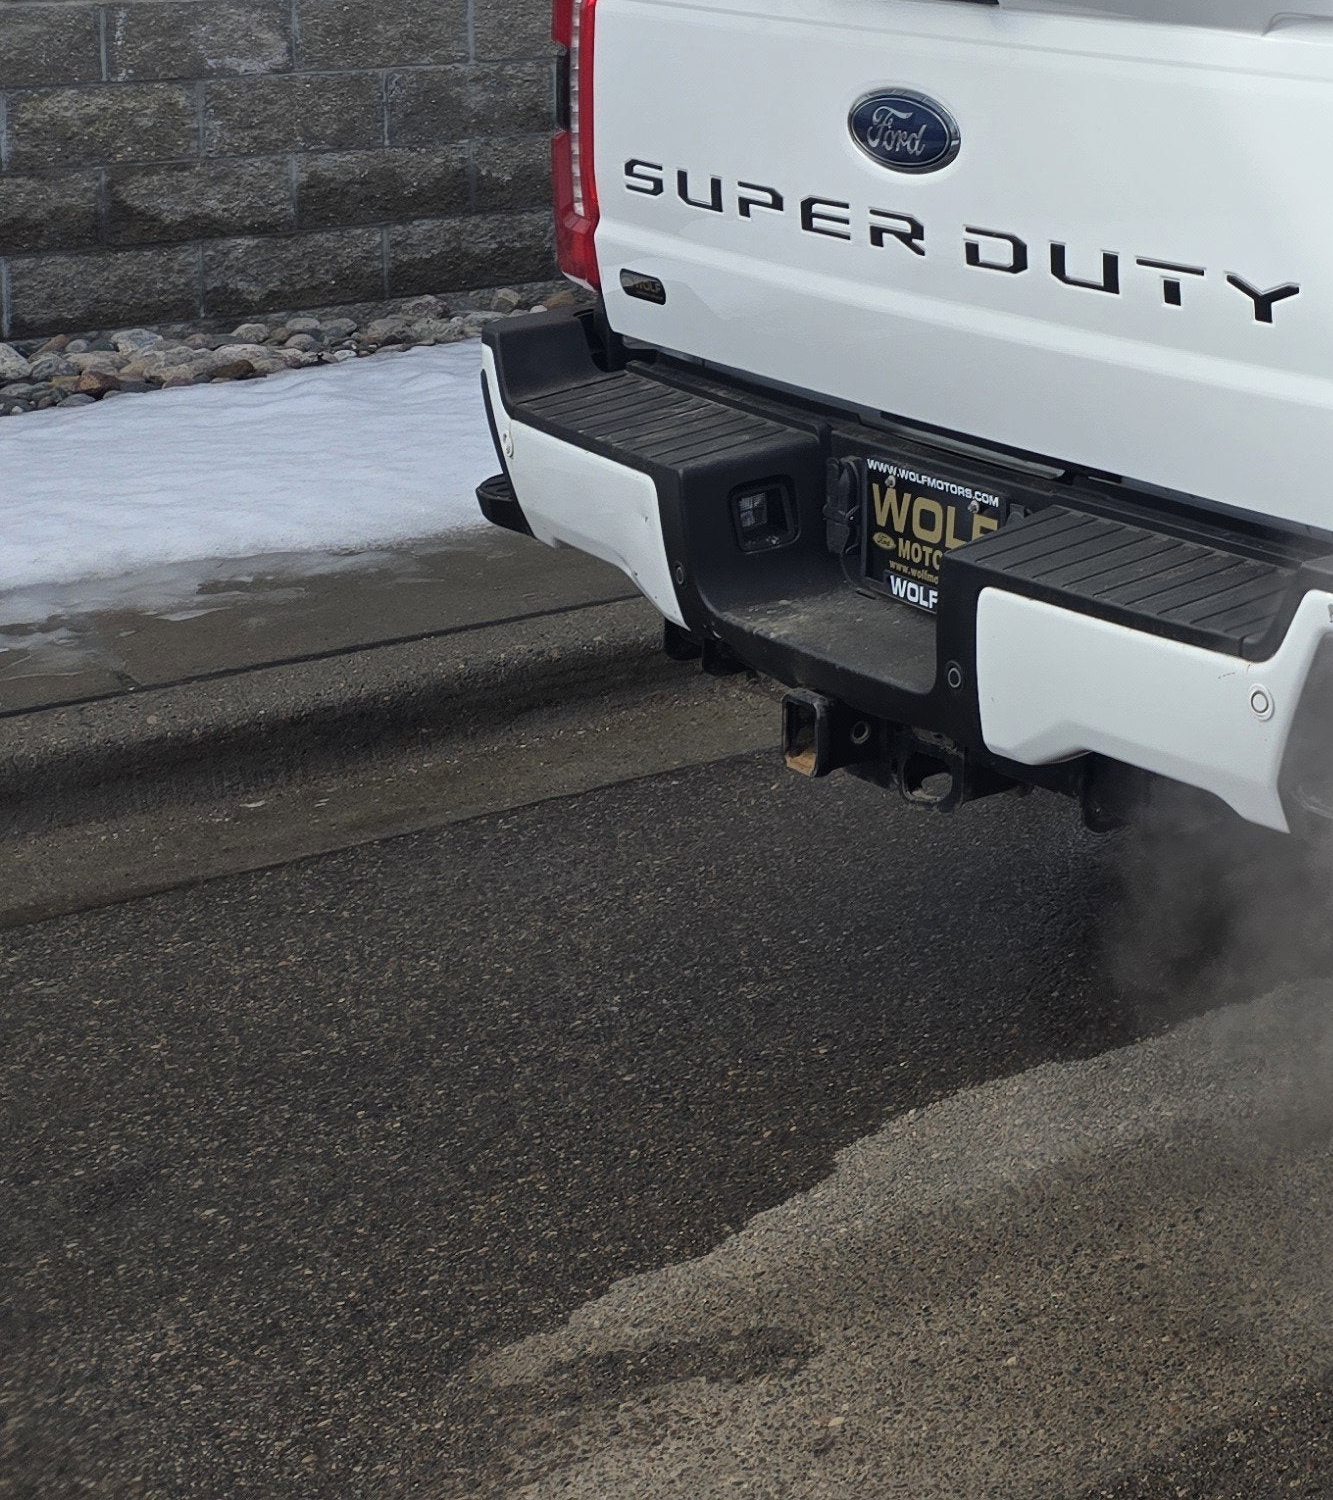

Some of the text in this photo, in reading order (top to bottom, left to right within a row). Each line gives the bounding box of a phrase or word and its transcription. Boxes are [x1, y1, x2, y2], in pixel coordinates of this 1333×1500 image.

[866, 105, 927, 157] Ford
[623, 157, 1301, 325] SUPER DUTY
[866, 458, 1000, 508] WWW.WOLFMOTORS.COM
[871, 482, 999, 549] WOLF
[888, 559, 940, 585] www.wolfmo
[897, 537, 943, 571] MOTO
[889, 574, 939, 609] WOLF
